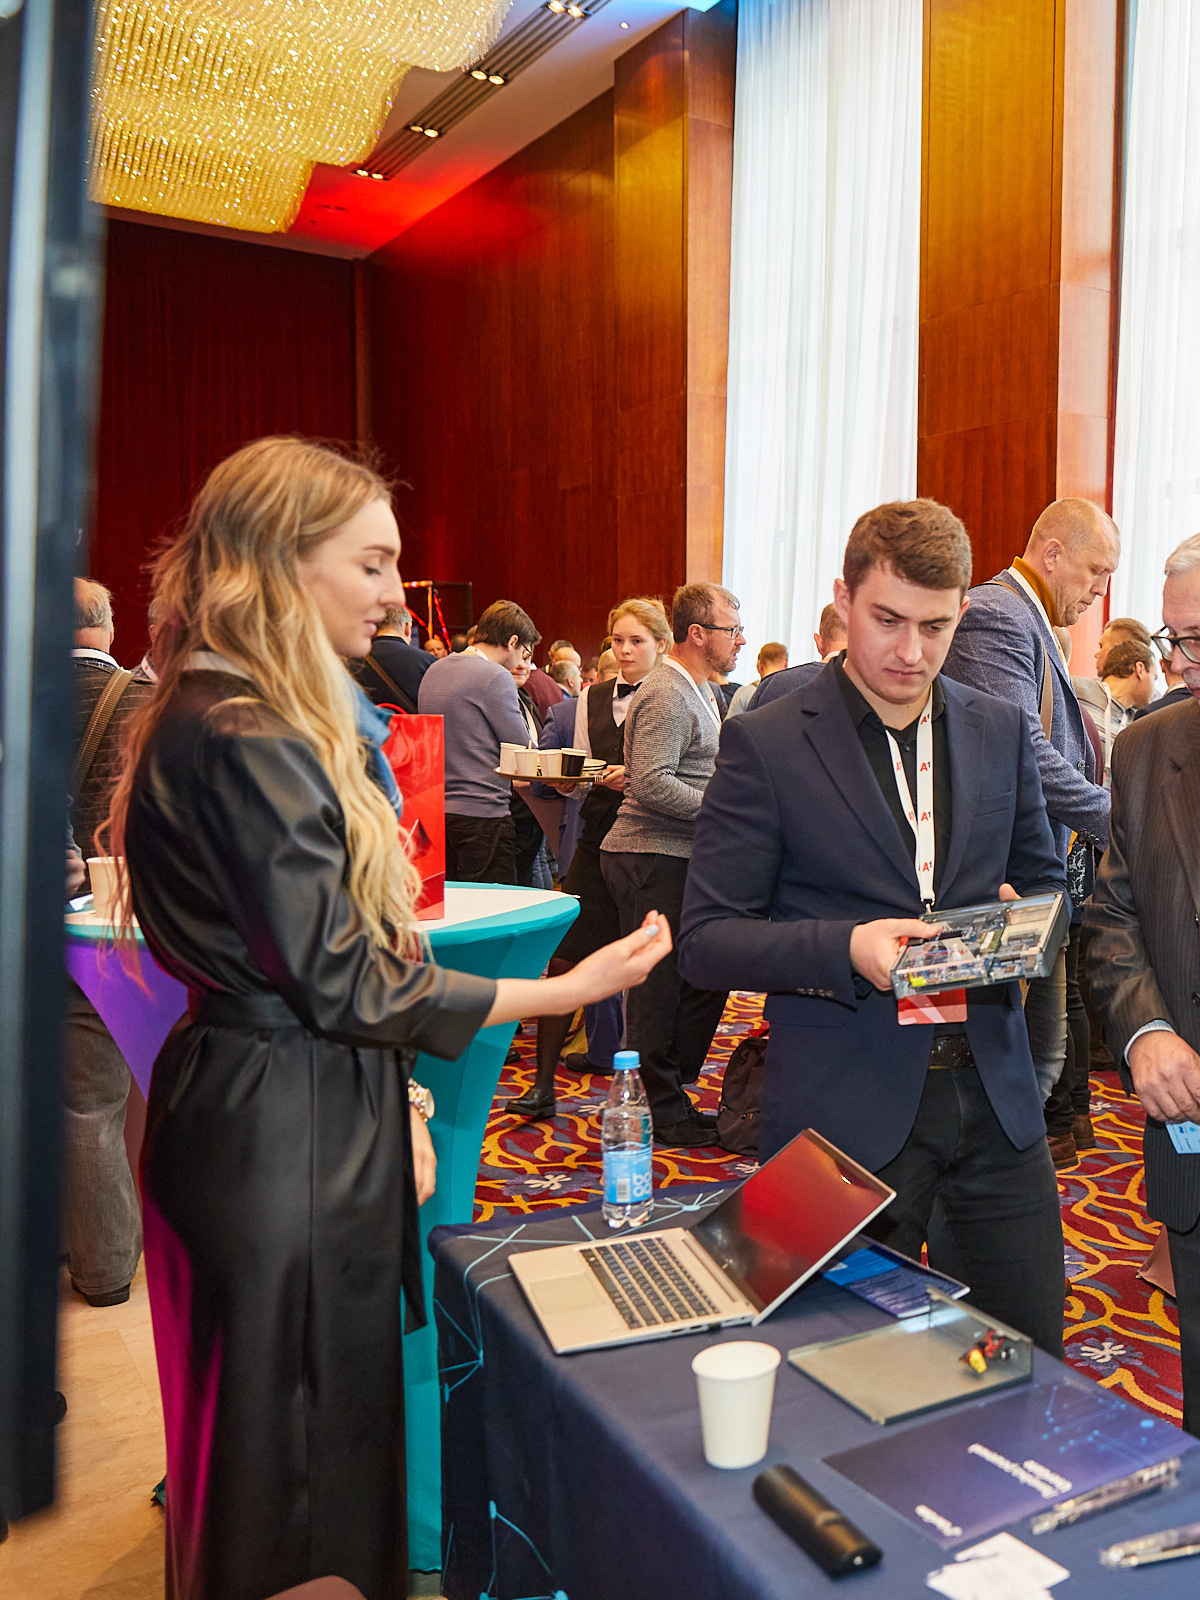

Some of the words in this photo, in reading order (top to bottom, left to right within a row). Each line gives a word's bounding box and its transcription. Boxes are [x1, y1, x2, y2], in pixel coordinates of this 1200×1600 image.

[920, 713, 930, 725] A1
[920, 761, 931, 772] A1
[921, 811, 932, 822] A1
[922, 861, 933, 872] A1
